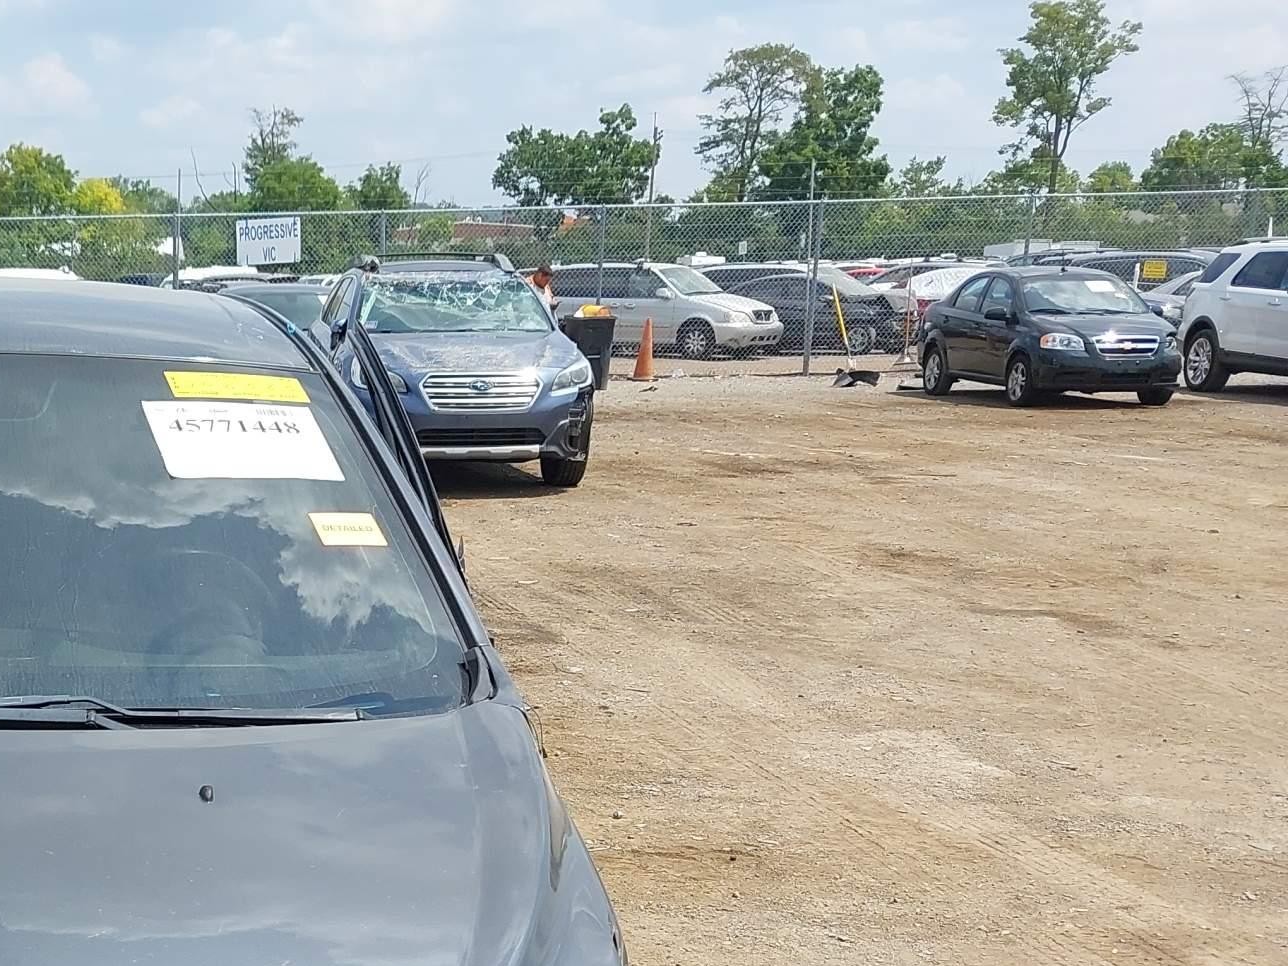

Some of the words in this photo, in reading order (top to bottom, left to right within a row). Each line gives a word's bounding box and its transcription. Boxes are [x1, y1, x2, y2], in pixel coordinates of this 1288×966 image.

[239, 223, 298, 241] PROGRESSIVE
[263, 246, 276, 262] VIC
[169, 419, 300, 434] 45771448
